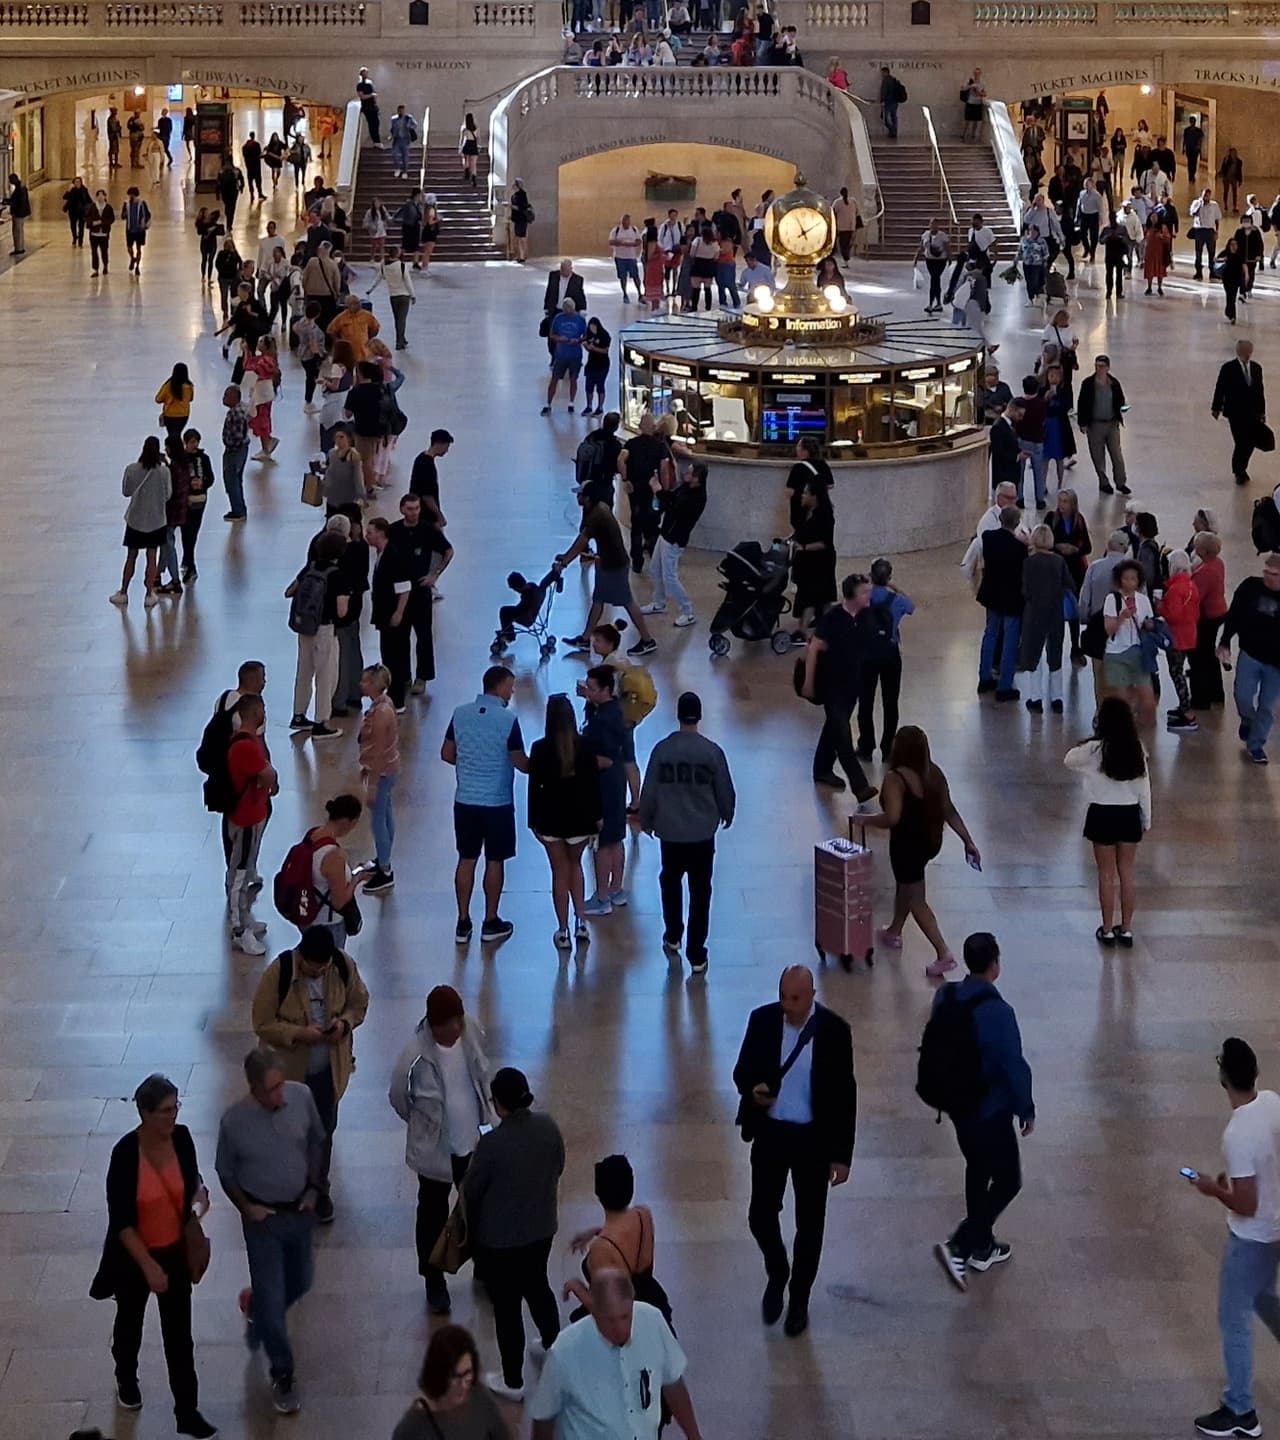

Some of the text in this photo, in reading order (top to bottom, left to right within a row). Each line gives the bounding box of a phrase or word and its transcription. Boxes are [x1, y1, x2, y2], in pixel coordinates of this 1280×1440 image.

[396, 62, 472, 70] WEST BALCONY
[66, 69, 141, 86] MACHINES
[188, 70, 244, 85] SUBWAY
[292, 83, 309, 95] ST
[1030, 69, 1149, 93] TICKET MACHINES
[1194, 69, 1246, 82] TRACKS
[785, 318, 842, 331] Information
